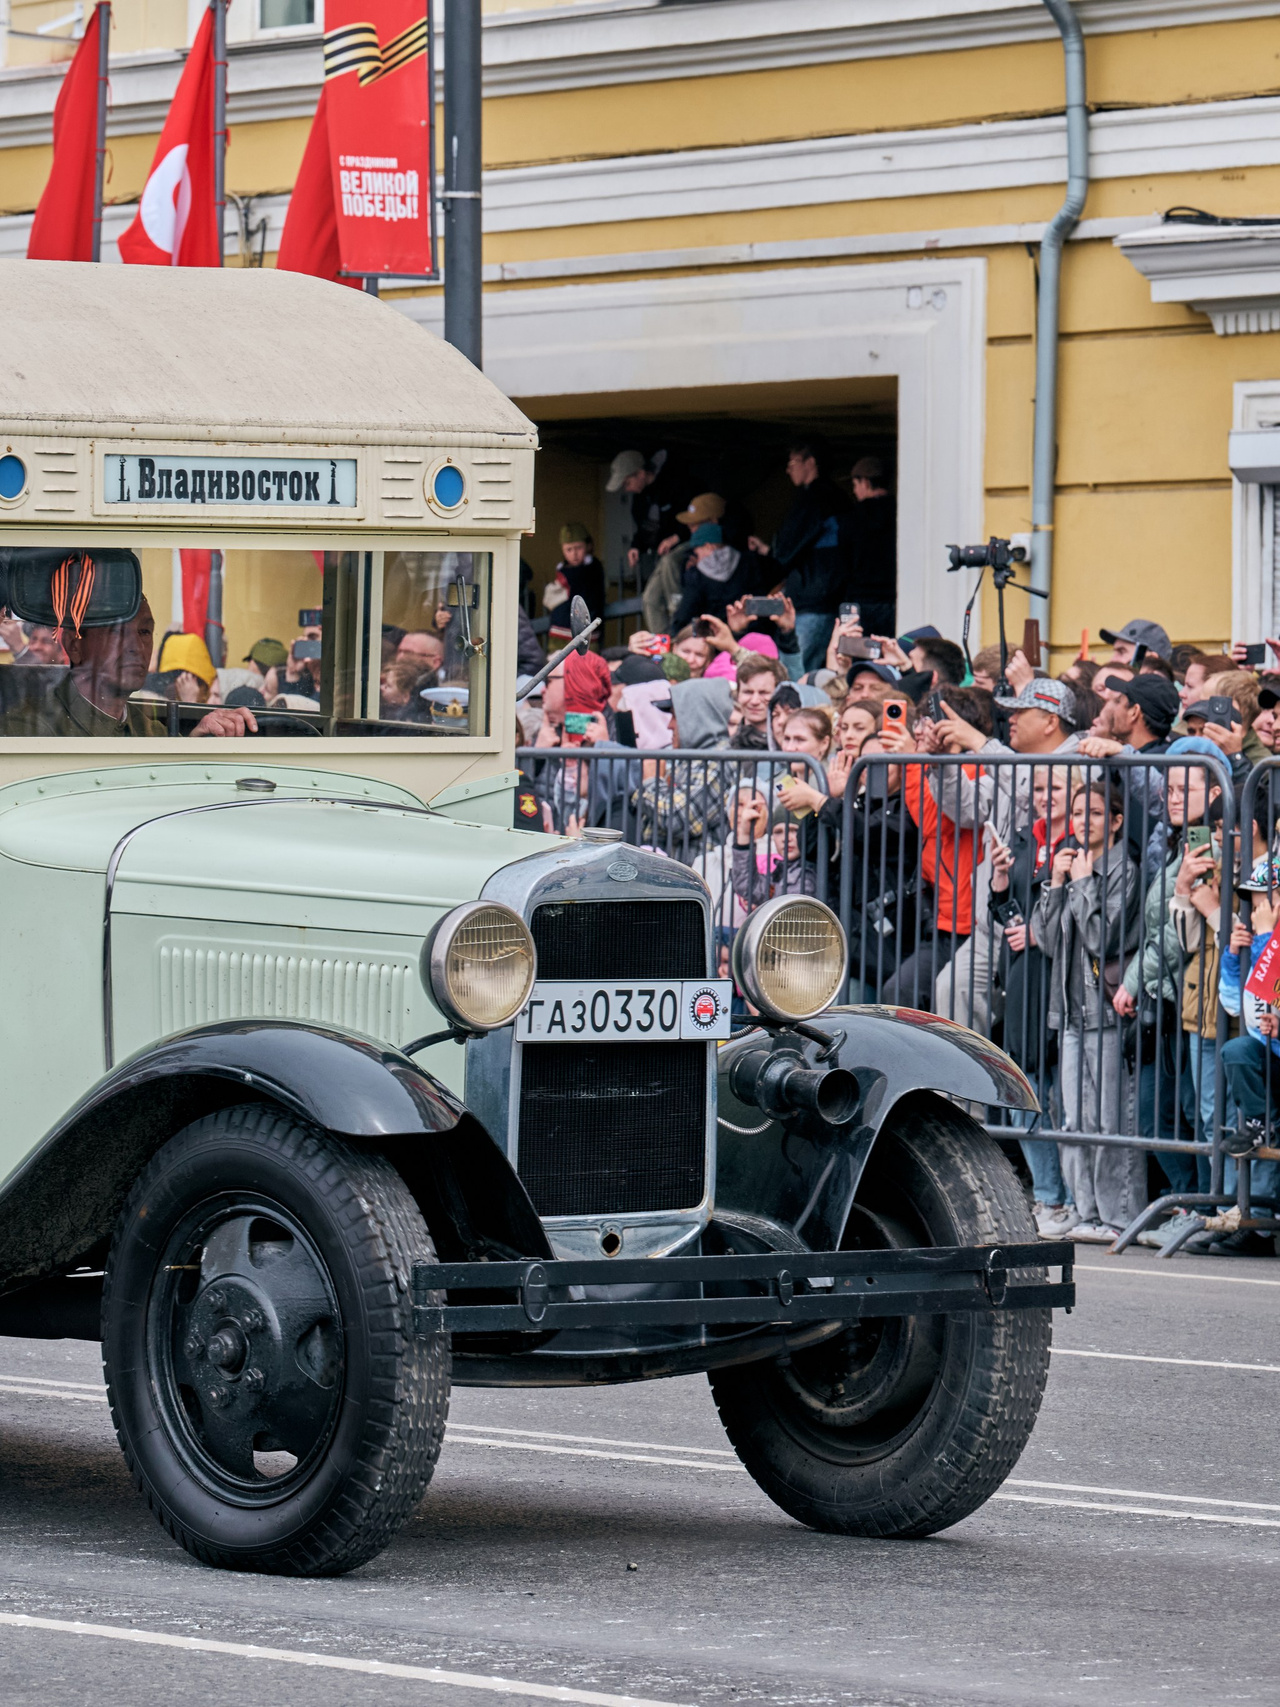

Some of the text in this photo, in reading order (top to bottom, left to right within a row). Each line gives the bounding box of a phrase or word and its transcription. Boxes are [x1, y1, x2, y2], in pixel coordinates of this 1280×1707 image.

[340, 170, 418, 195] ВЕЛИКОЙ
[342, 194, 418, 221] ПОБЕДЫ!
[138, 458, 320, 504] Владивосток
